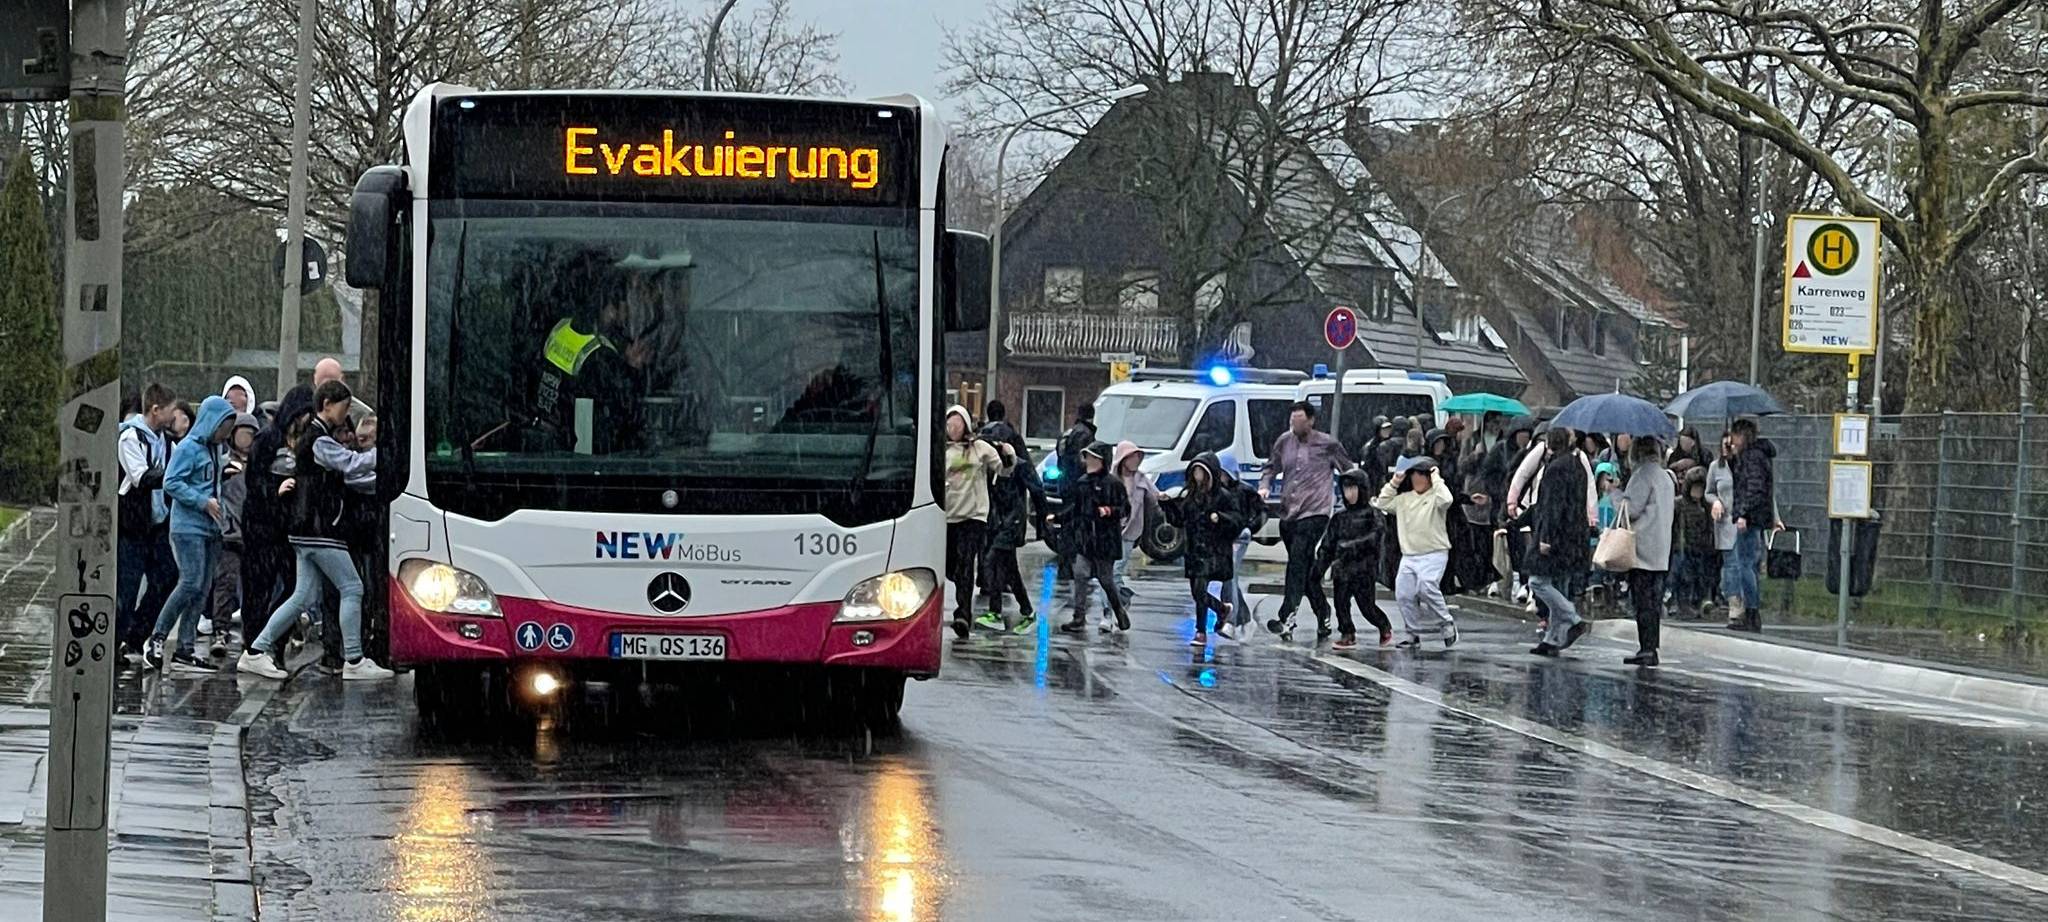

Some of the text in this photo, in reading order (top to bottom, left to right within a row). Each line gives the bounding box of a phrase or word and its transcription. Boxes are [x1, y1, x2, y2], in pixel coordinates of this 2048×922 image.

[566, 127, 879, 189] Evakuierung
[1823, 234, 1844, 265] H
[1798, 285, 1865, 301] Karrenweg
[1789, 304, 1804, 316] 015
[1822, 335, 1848, 346] NEW
[678, 544, 742, 561] MöBus
[794, 533, 857, 556] 1306
[623, 636, 723, 656] MG QS 136
